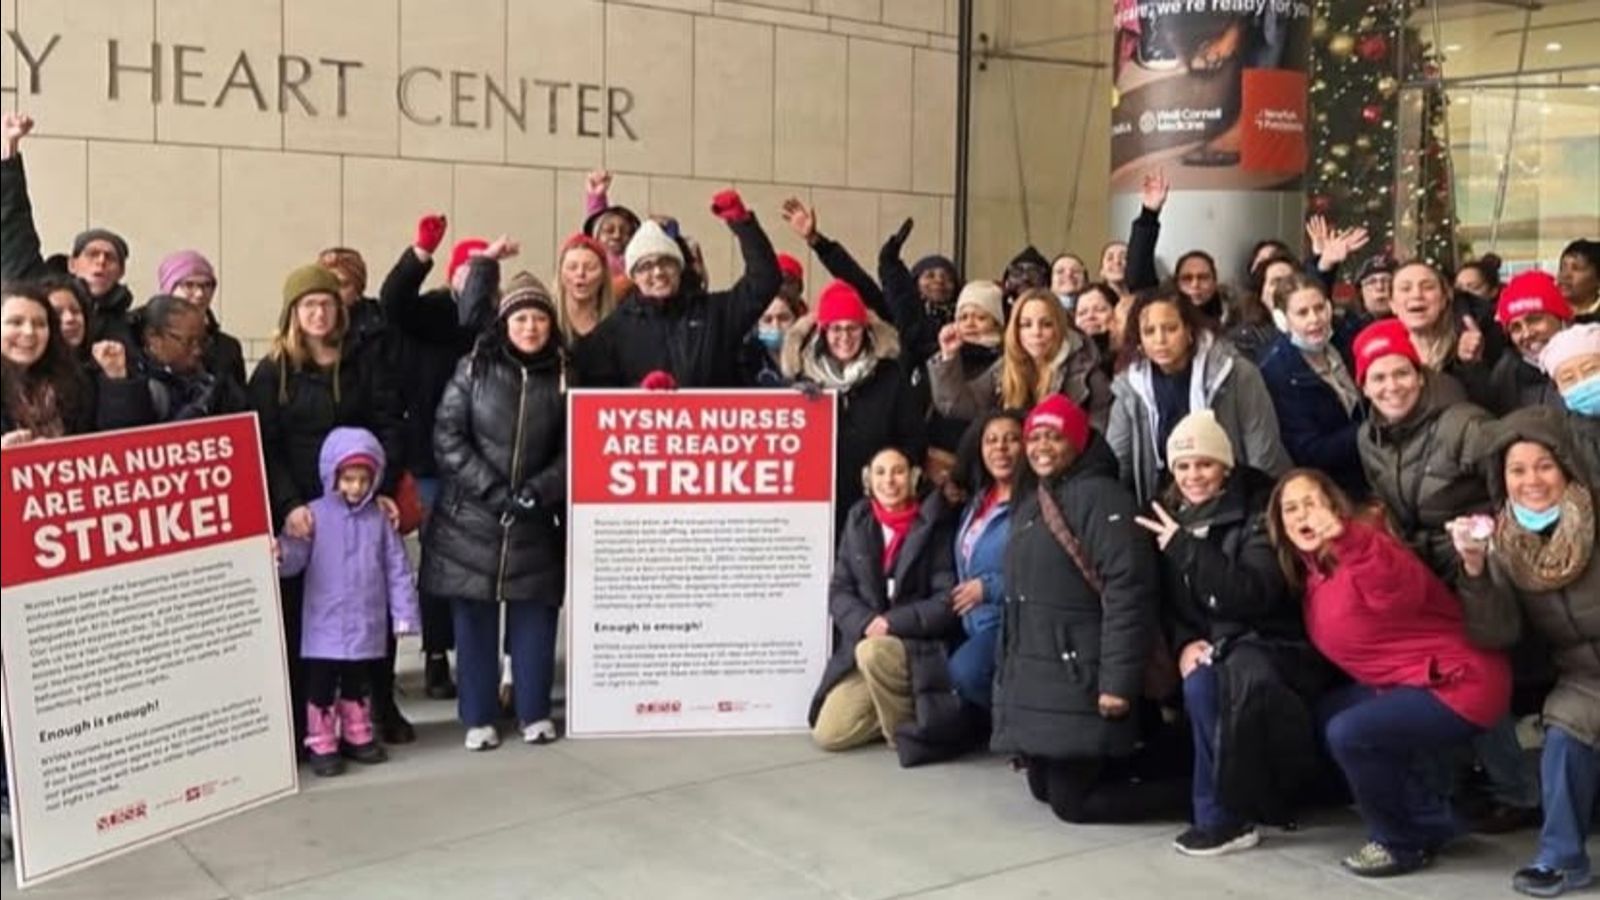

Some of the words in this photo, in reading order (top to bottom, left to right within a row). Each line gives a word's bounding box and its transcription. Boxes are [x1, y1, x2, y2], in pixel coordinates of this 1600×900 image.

[1, 30, 62, 95] Y
[107, 39, 364, 119] HEART
[396, 66, 639, 142] CENTER
[598, 408, 694, 431] NYSNA
[700, 408, 807, 430] NURSES
[603, 434, 658, 455] ARE
[666, 434, 759, 455] READY
[765, 434, 801, 455] TO
[11, 453, 119, 491] NYSNA
[125, 436, 234, 473] NURSES
[608, 461, 795, 496] STRIKE!
[23, 488, 85, 521] ARE
[93, 467, 189, 509] READY
[195, 464, 233, 491] TO
[34, 494, 233, 568] STRIKE!
[39, 719, 91, 743] Enough
[93, 716, 104, 729] is
[107, 698, 159, 725] enough!
